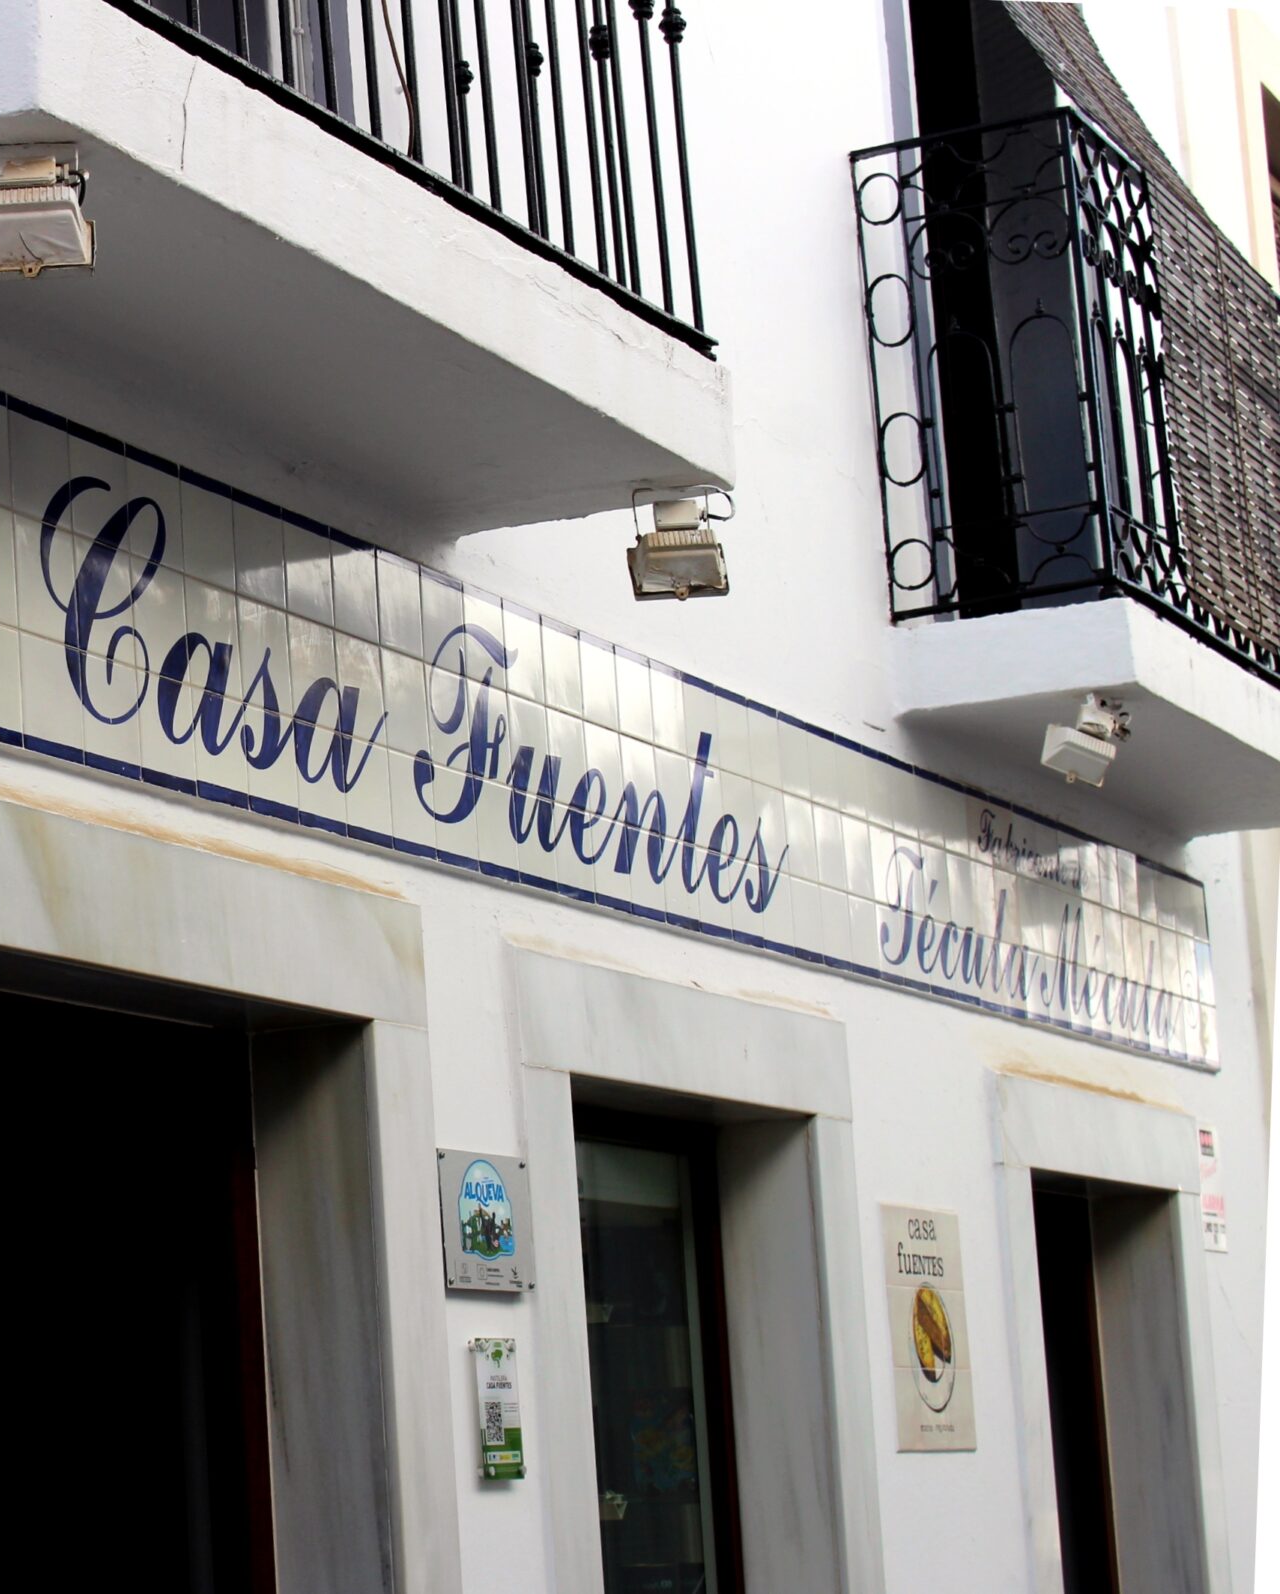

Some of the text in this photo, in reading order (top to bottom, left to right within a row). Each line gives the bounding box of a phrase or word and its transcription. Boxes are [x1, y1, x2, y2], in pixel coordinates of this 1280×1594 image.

[39, 475, 789, 914] Casa Fuentes
[879, 845, 1039, 1002] Técula
[464, 1182, 505, 1207] ALQUEVA
[907, 1217, 937, 1241] casa
